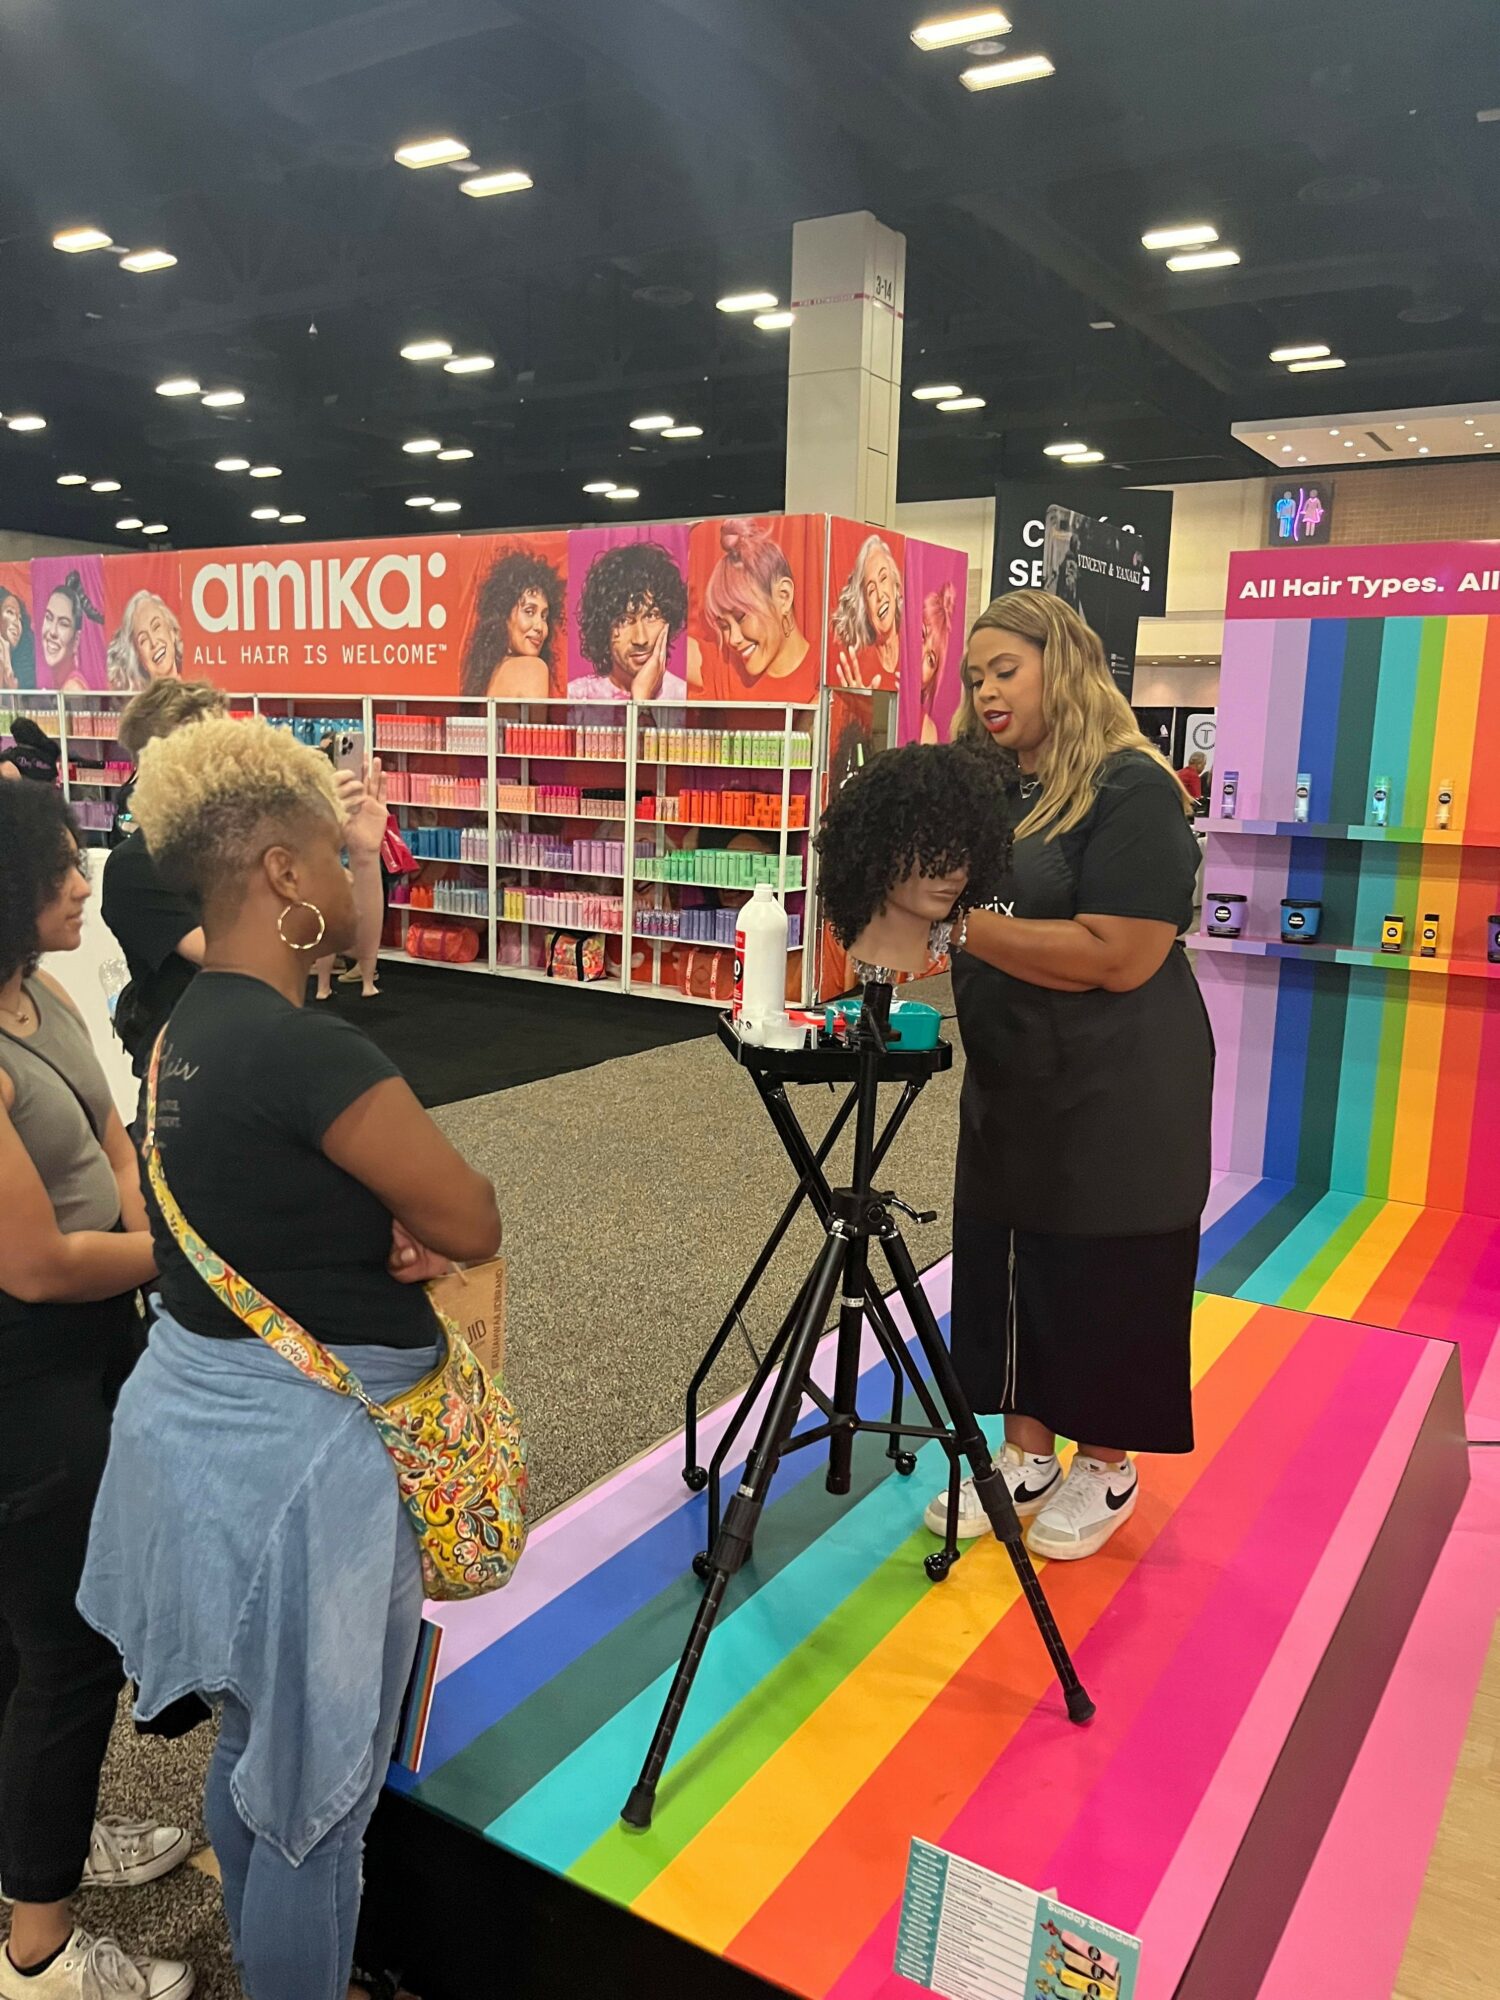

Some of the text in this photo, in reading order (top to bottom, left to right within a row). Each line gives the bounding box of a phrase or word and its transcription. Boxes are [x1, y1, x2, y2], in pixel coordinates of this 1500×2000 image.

[876, 275, 892, 301] 3-14
[1077, 554, 1107, 577] VINCENT
[1108, 563, 1115, 577] &
[1239, 570, 1500, 599] All Hair Types. All
[194, 645, 228, 665] ALL
[240, 645, 289, 665] HAIR
[304, 645, 328, 665] IS
[1047, 1901, 1140, 1950] Sunday Schedule
